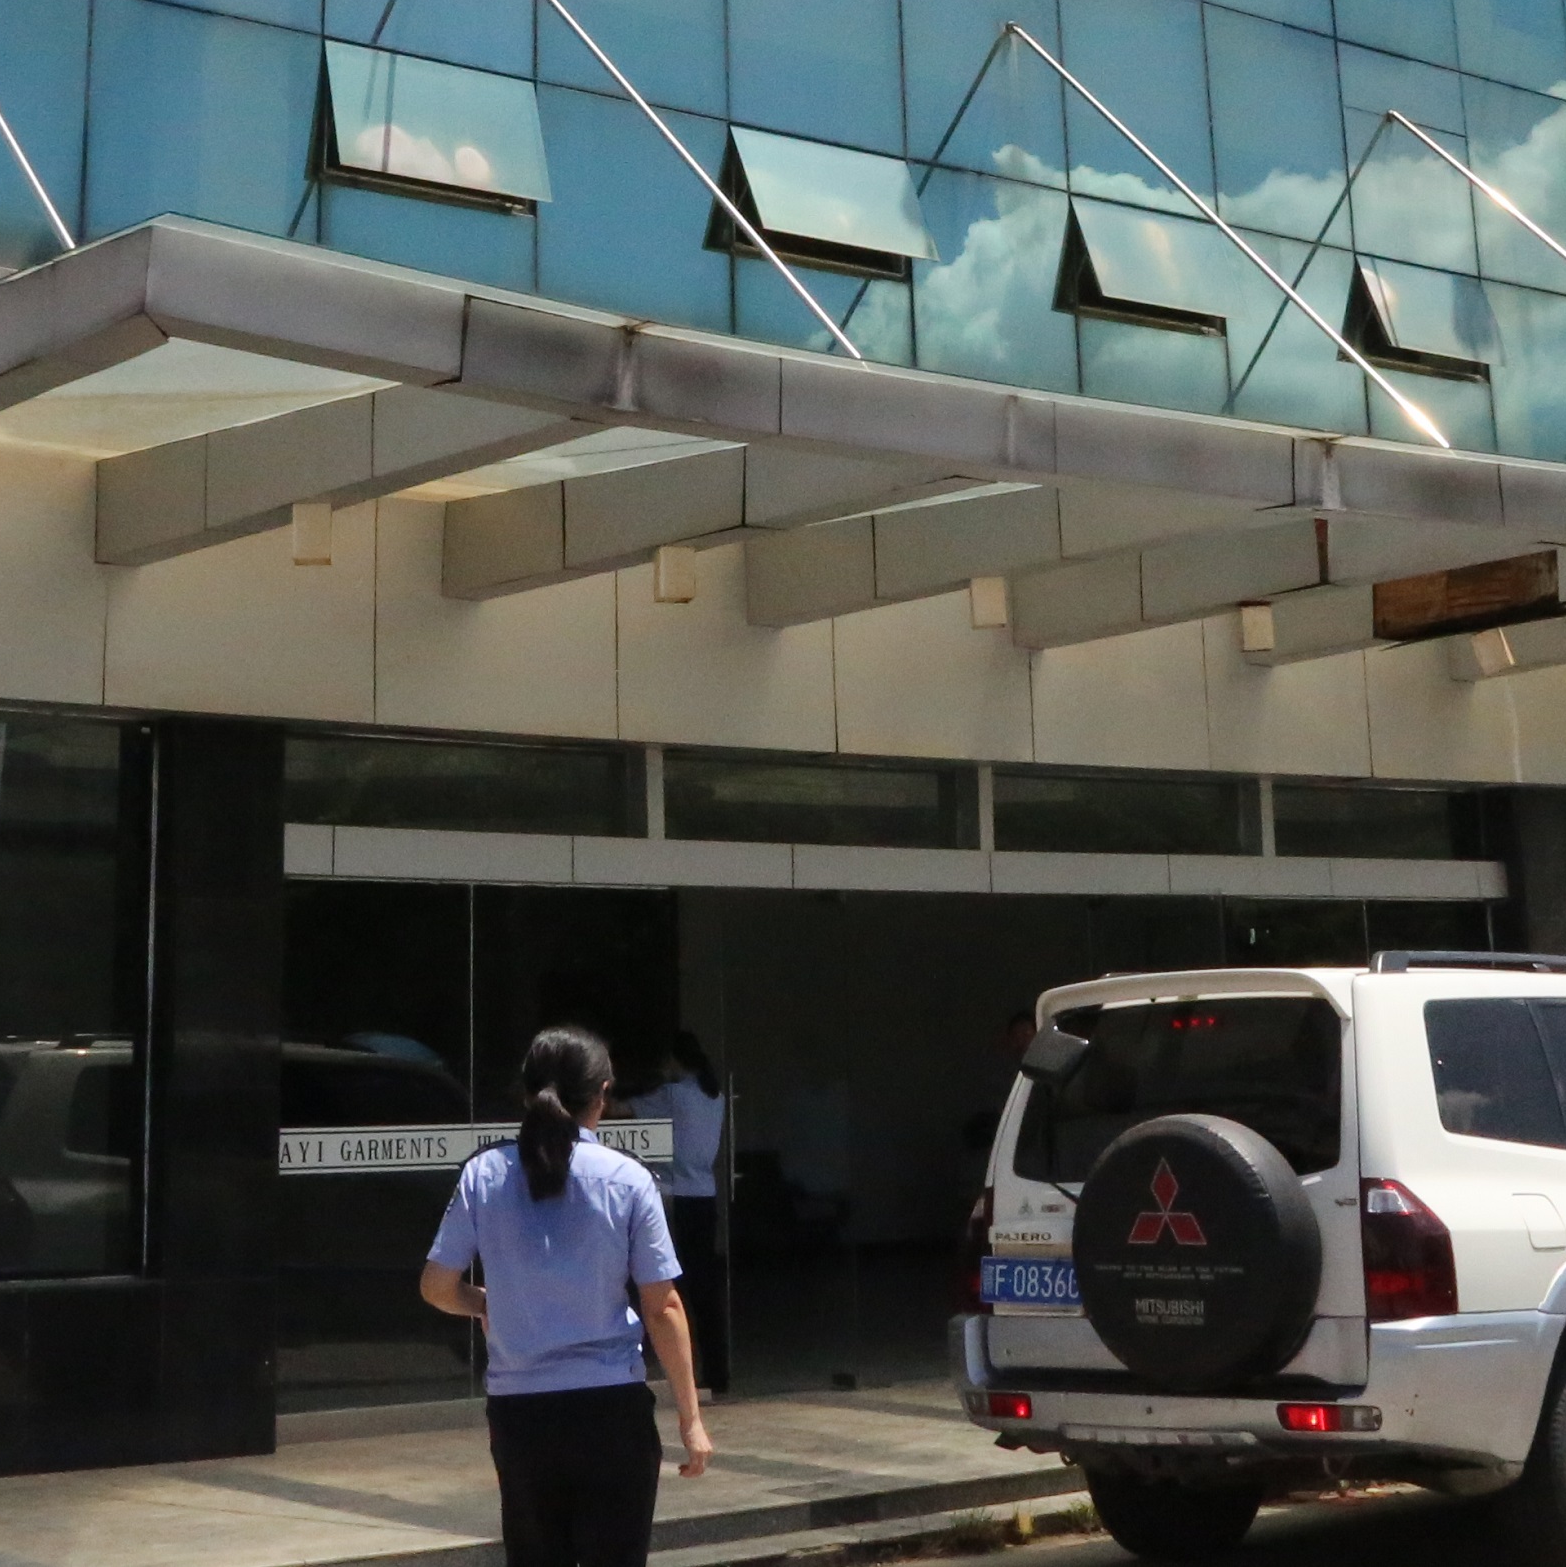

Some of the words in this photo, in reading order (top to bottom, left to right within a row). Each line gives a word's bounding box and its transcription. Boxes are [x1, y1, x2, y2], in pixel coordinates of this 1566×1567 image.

[340, 1136, 448, 1162] GARMENTS
[995, 1232, 1053, 1242] PAJERO
[1135, 1298, 1205, 1316] MITSUBISHI
